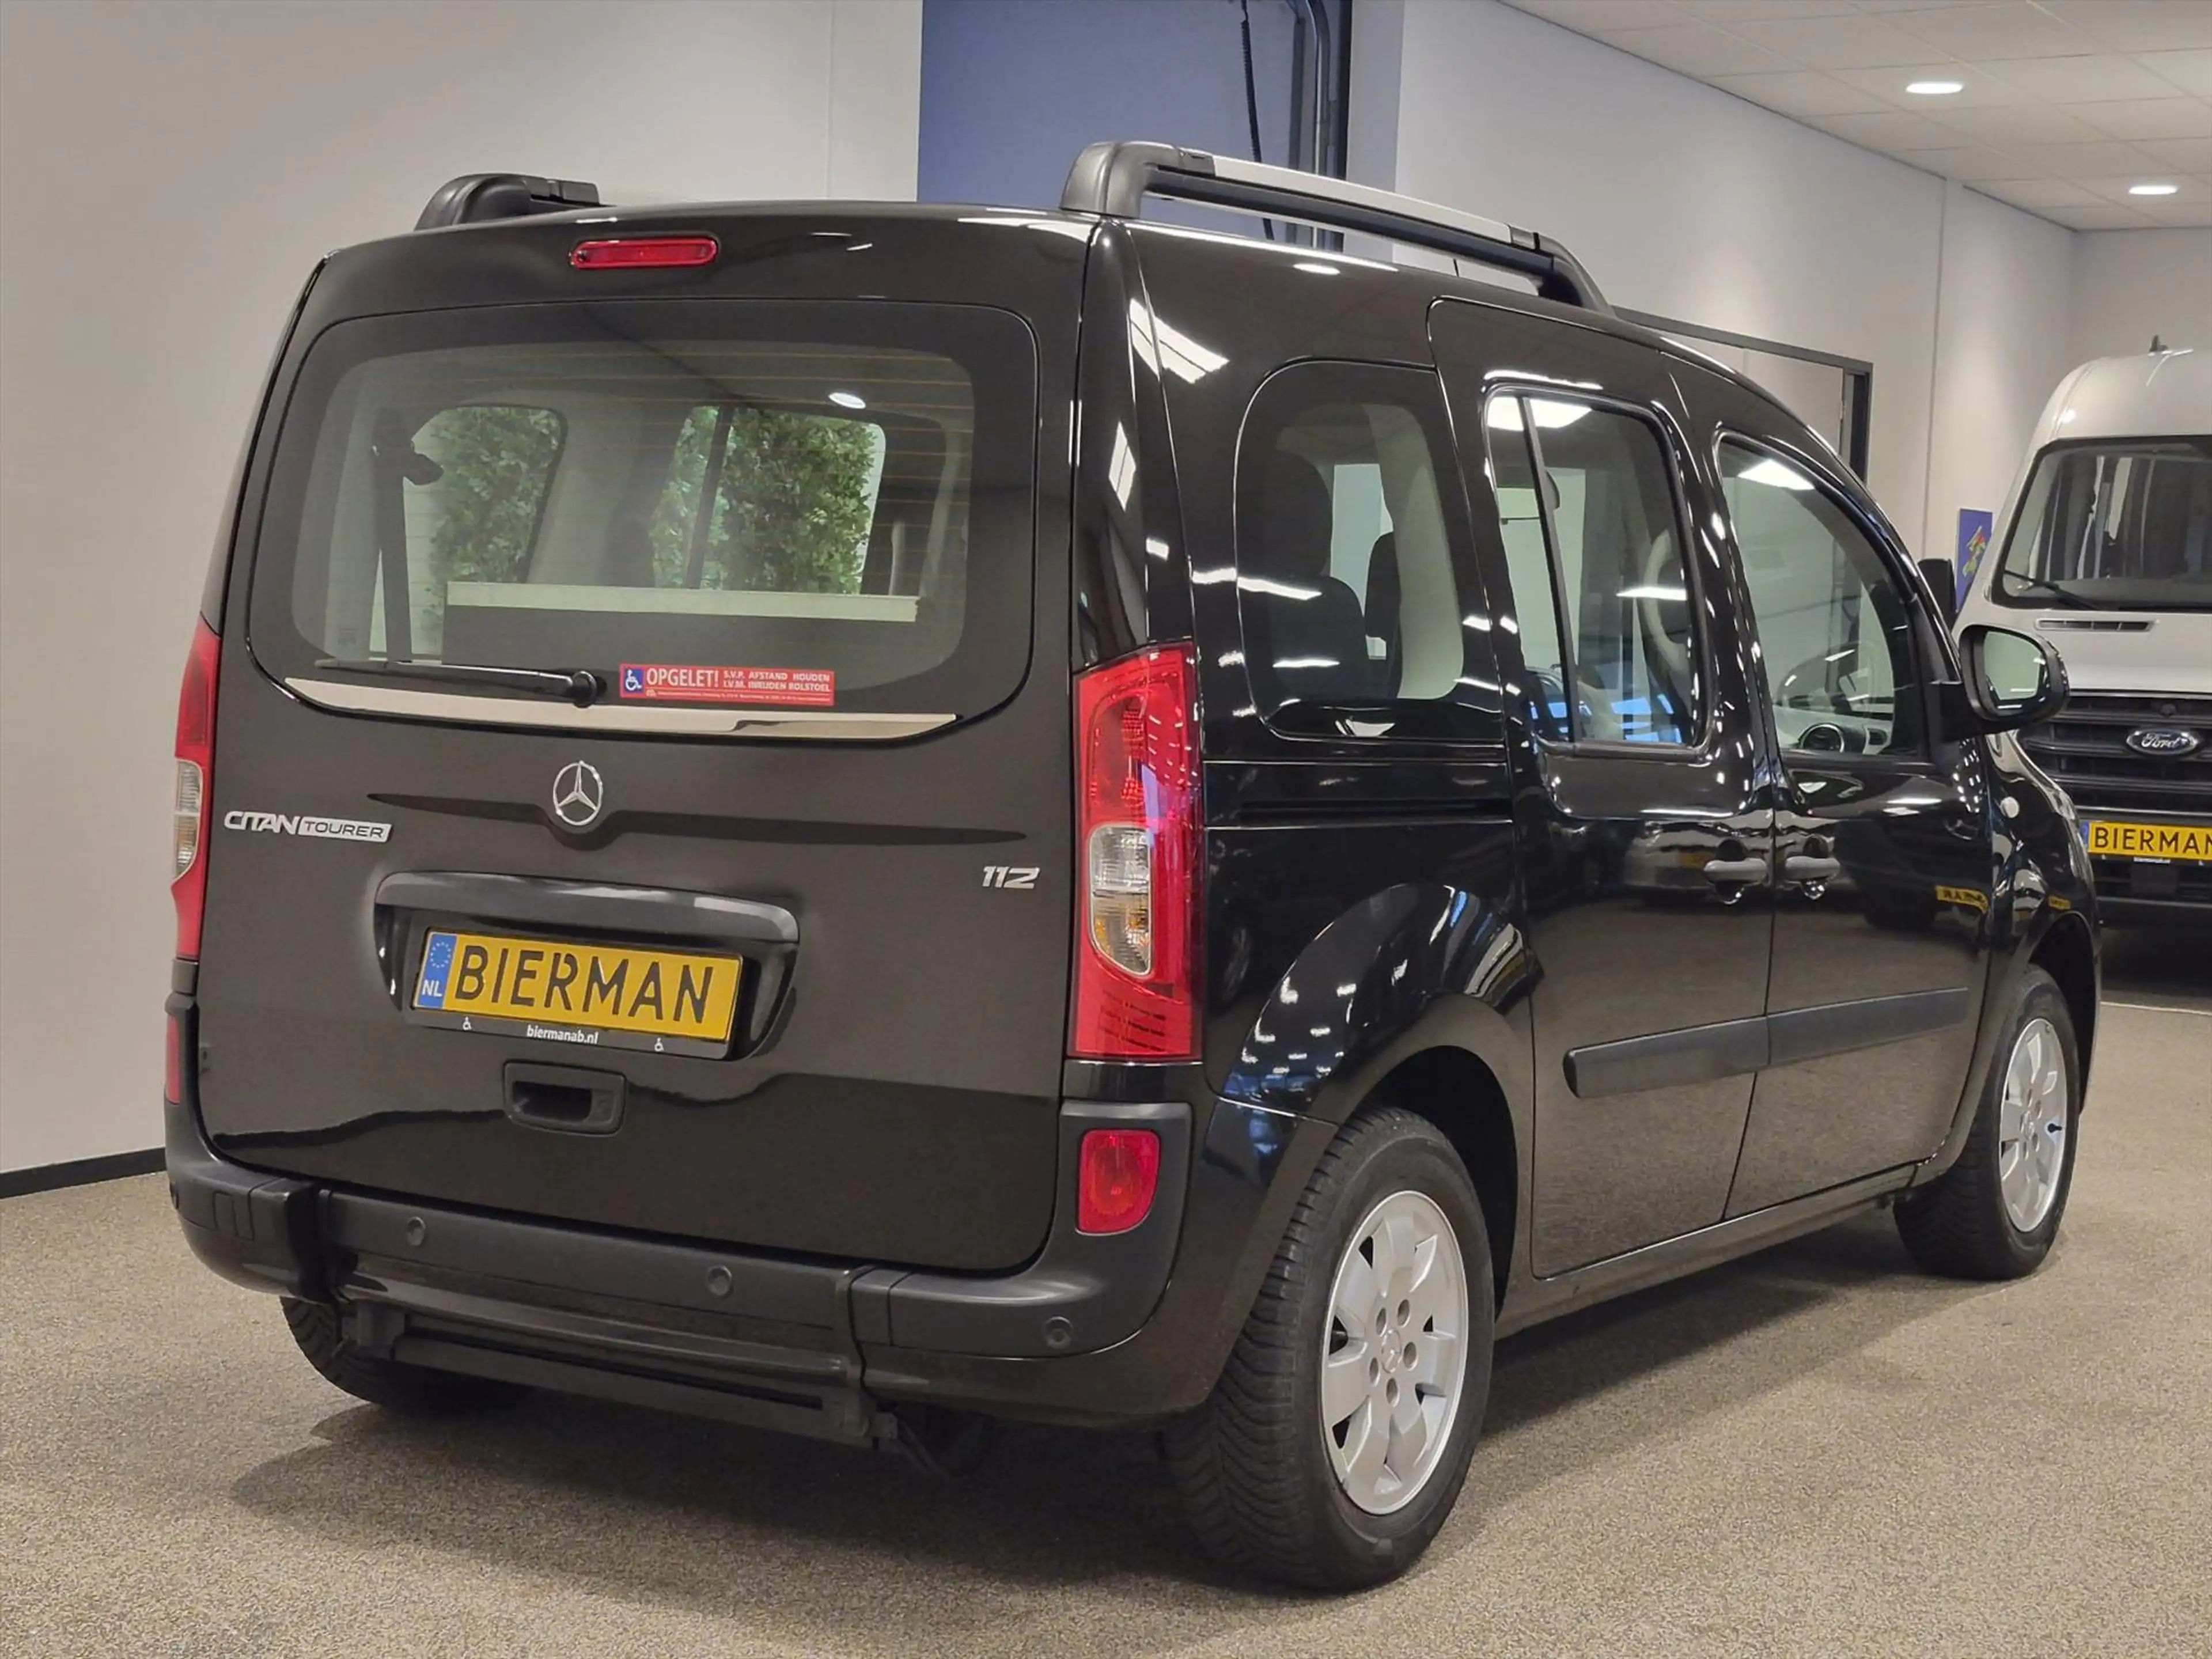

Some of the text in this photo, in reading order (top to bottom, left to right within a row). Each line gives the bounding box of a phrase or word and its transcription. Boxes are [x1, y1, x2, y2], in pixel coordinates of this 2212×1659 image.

[646, 668, 719, 687] OPGELET!
[749, 671, 788, 680] AFSTAND
[793, 673, 830, 681] HOUDEN
[224, 811, 384, 838] CITAN TOURER
[982, 866, 1040, 889] 112
[422, 979, 442, 997] NL
[455, 945, 714, 1024] BIERMAN
[527, 1024, 599, 1044] biermanab.nl
